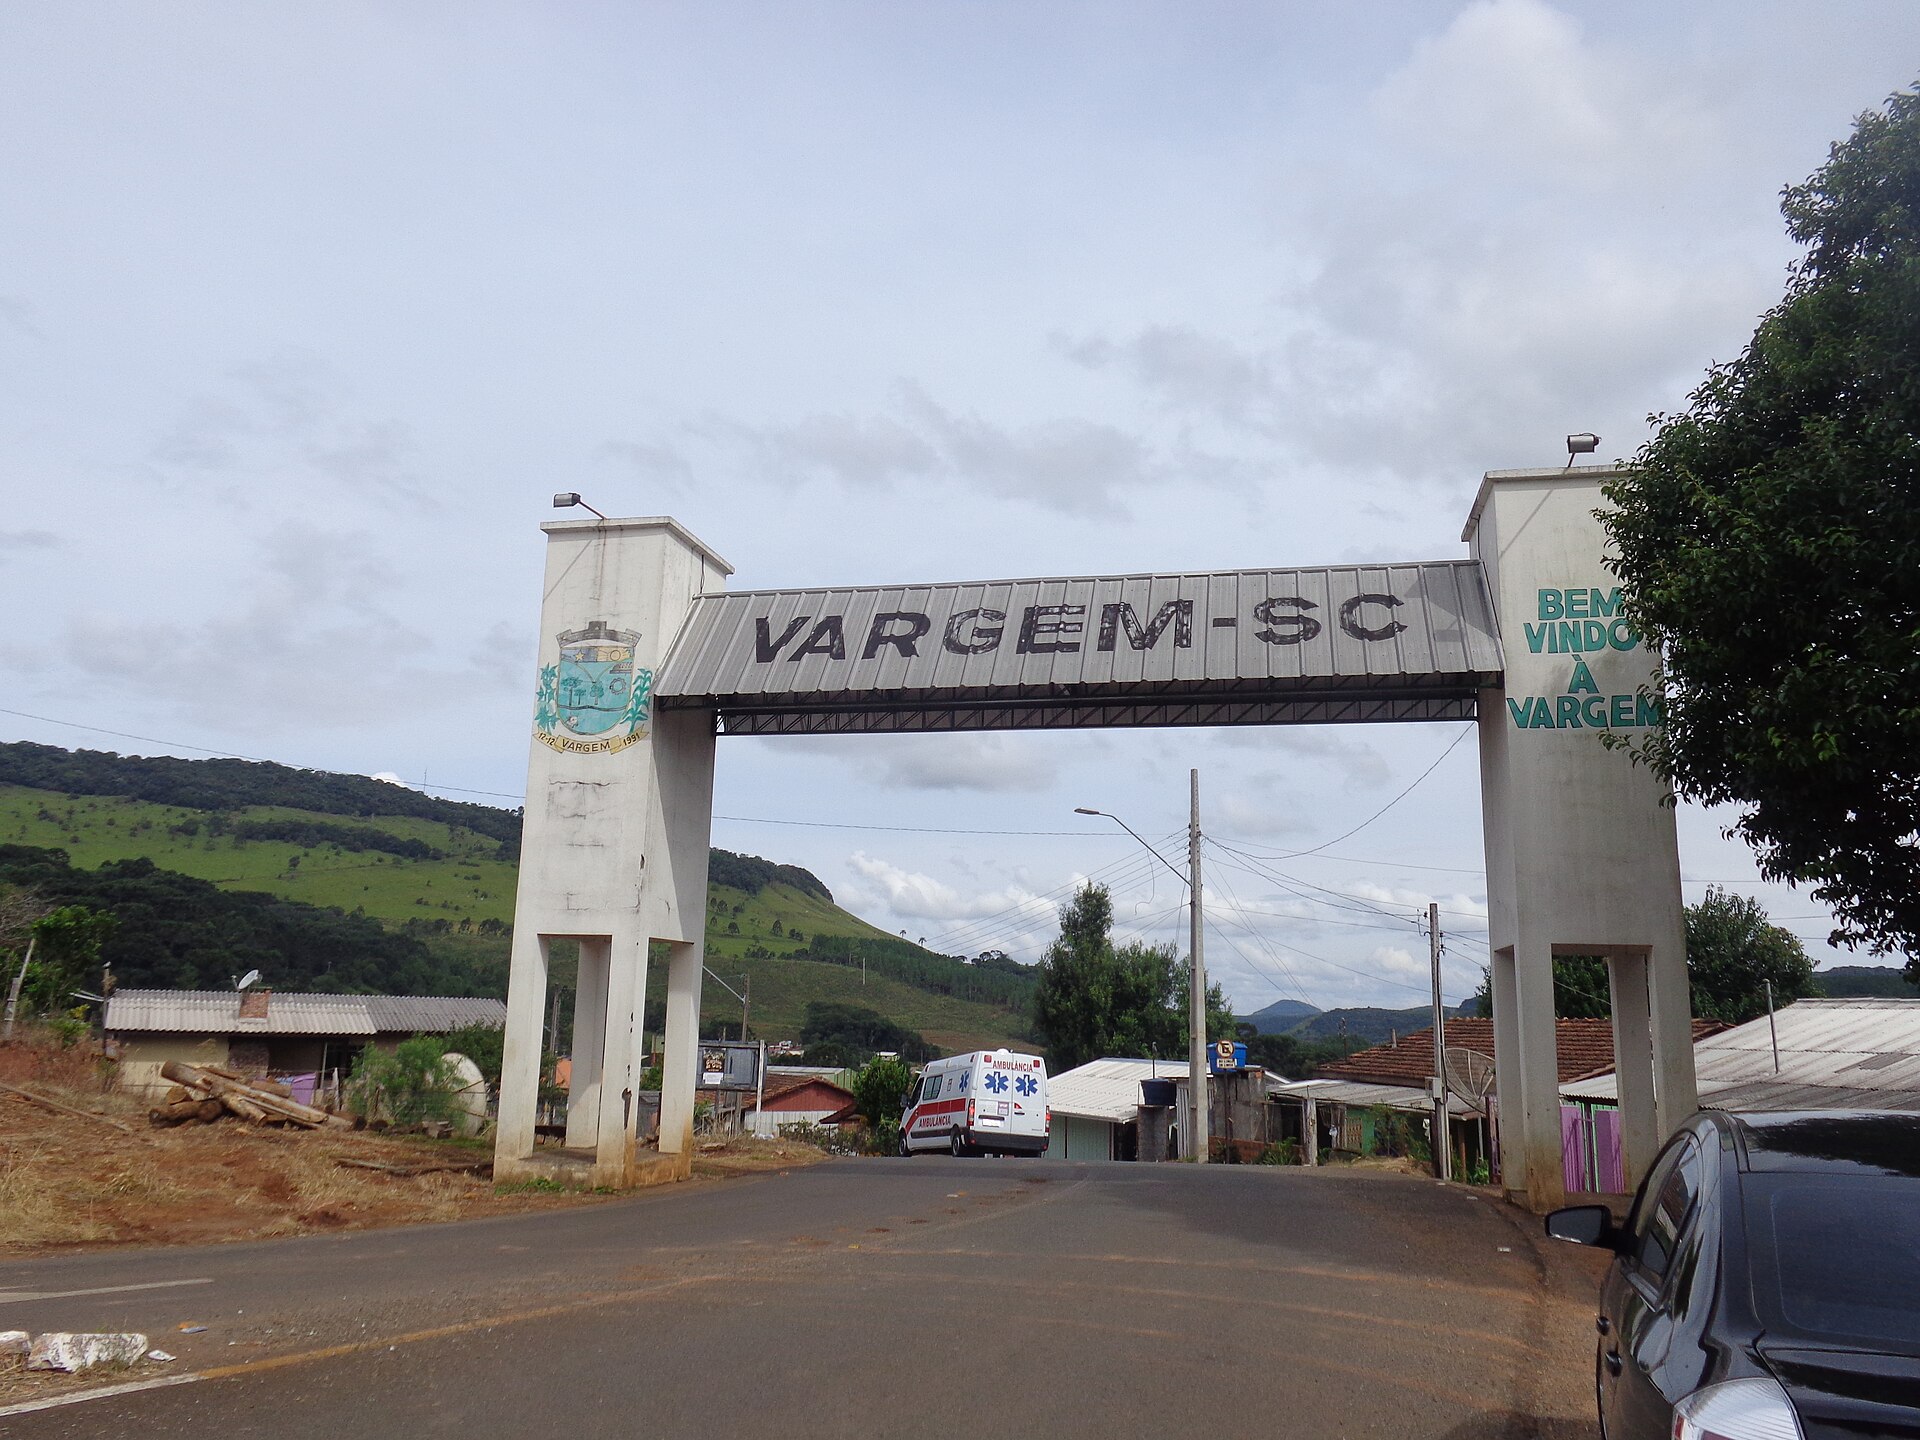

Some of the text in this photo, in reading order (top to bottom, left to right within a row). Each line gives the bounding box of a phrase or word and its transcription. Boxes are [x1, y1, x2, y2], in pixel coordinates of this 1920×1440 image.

[1538, 587, 1626, 620] BEM
[1523, 618, 1642, 654] VINDO
[1567, 654, 1599, 694] À
[1506, 694, 1663, 729] VARGEM
[538, 732, 641, 753] 12-12 VARGEM 1991
